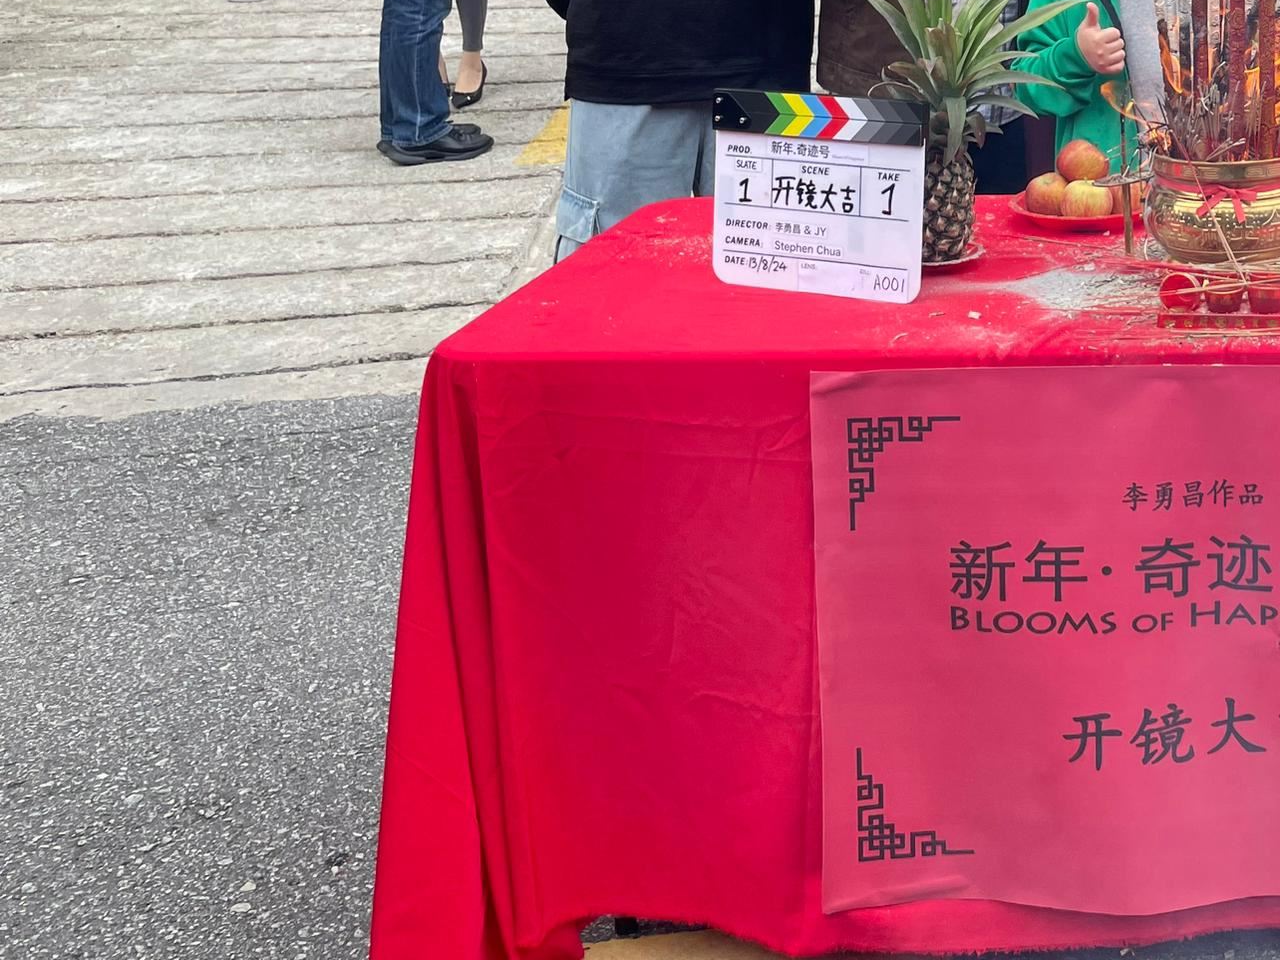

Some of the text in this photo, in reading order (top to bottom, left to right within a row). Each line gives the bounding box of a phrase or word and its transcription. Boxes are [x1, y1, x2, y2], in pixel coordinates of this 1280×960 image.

[727, 144, 752, 154] PROD.
[736, 159, 757, 170] SLATE
[801, 165, 830, 176] SCENE
[878, 172, 901, 182] TAKE
[738, 177, 753, 203] 1
[772, 176, 856, 213] 开镜大吉
[881, 183, 896, 216] 1
[804, 226, 811, 235] &
[814, 226, 827, 237] JY
[774, 240, 814, 255] Stephen
[816, 247, 841, 257] Chua
[749, 255, 787, 273] 13/8/24
[873, 274, 905, 292] A001
[1121, 478, 1265, 512] 李勇昌作品
[951, 606, 1116, 634] BLOOMS
[1131, 611, 1175, 634] OF
